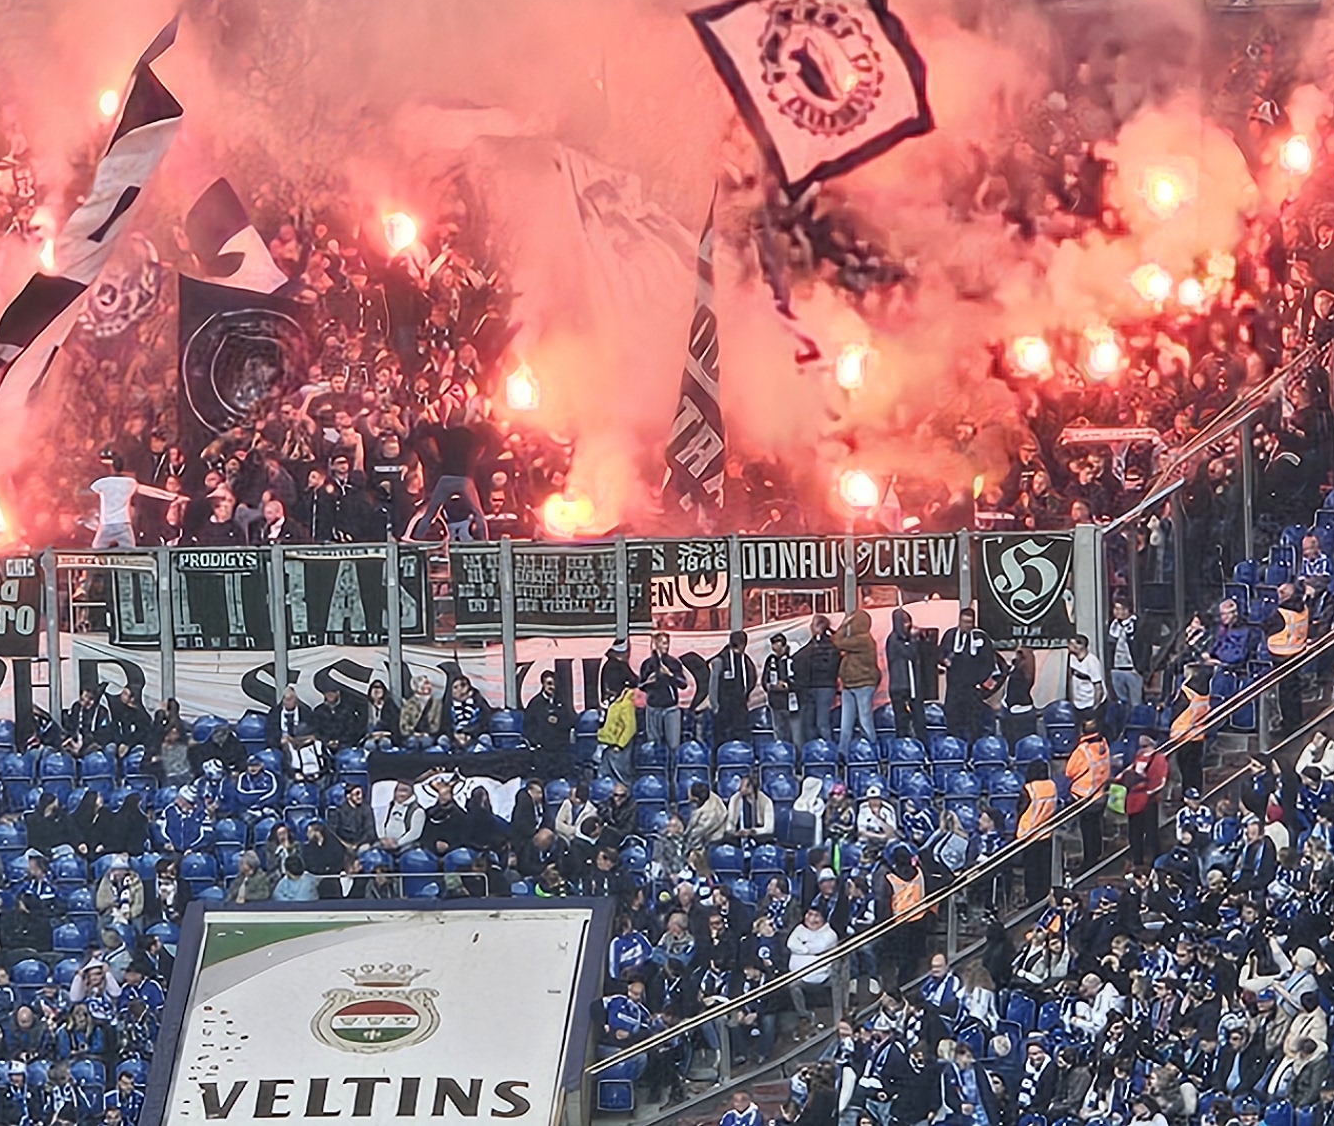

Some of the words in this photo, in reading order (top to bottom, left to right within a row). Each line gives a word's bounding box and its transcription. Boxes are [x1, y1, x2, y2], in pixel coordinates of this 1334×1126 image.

[179, 552, 258, 569] PRODIGYS
[742, 540, 837, 580] DONAU
[873, 537, 957, 578] CREW
[197, 1076, 533, 1121] VELTINS
